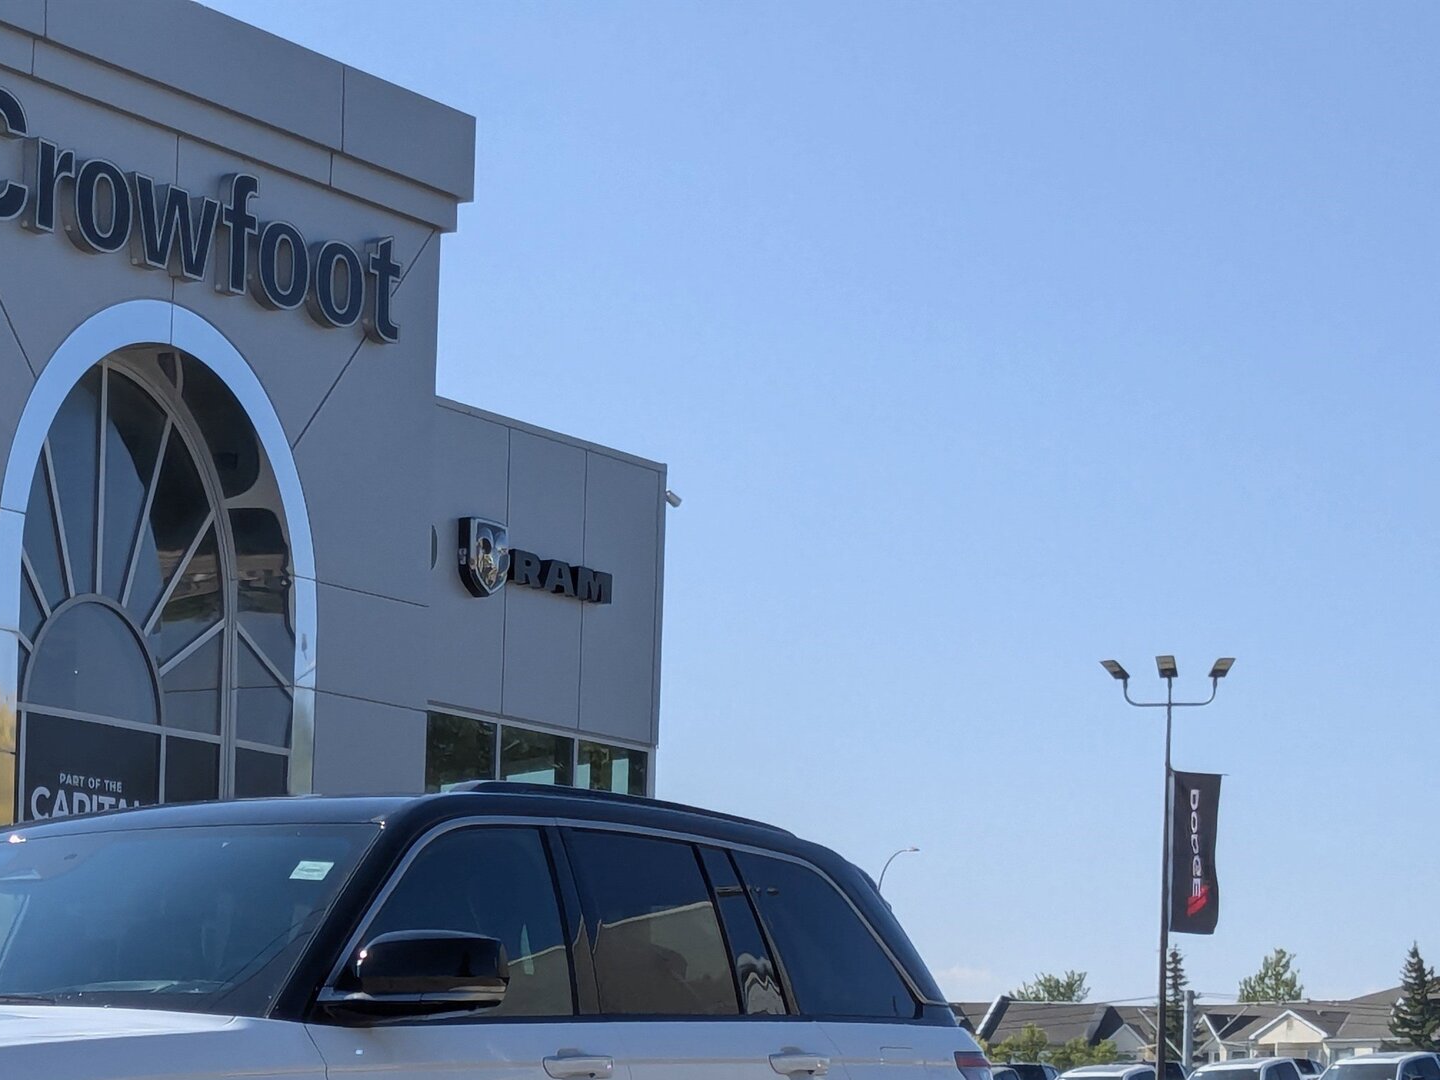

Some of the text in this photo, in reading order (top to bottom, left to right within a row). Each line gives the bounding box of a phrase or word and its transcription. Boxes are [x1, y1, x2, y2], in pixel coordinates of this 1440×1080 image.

[509, 548, 613, 605] RAM
[31, 786, 140, 821] CAPIT
[59, 773, 122, 793] PART OF THE
[1190, 789, 1202, 897] DODGE
